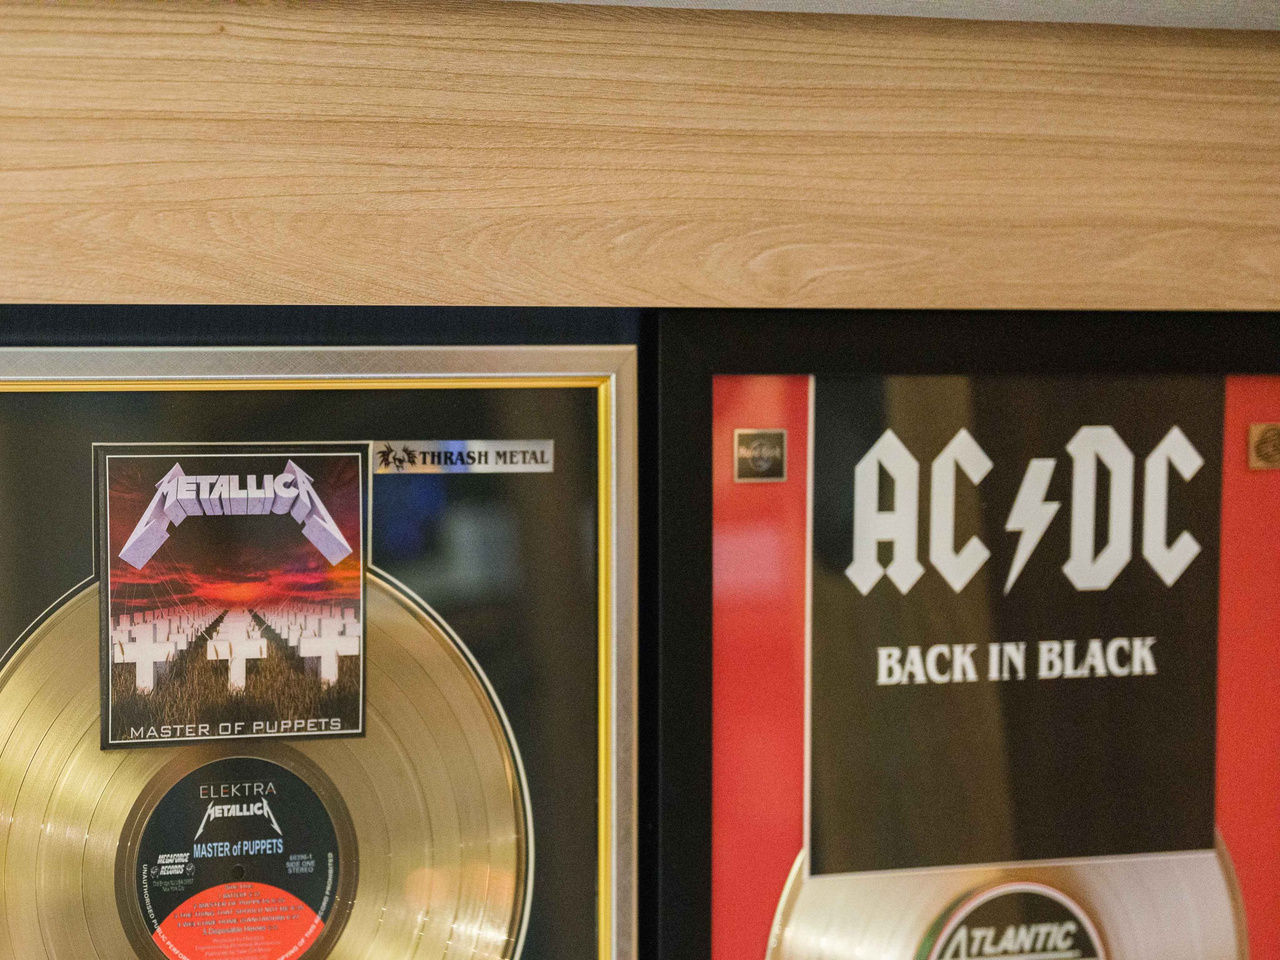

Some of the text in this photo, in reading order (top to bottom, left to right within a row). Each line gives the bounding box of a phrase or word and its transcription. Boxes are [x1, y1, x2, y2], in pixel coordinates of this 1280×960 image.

[419, 450, 549, 466] THRASH METAL
[118, 459, 354, 571] METALLICA
[876, 636, 1158, 687] BACK IN BLACK
[130, 718, 342, 739] MASTER OF PUPPETS
[199, 782, 277, 799] ELEKTRA
[194, 797, 283, 841] METALLICA
[193, 838, 284, 859] MASTER of PUPPETS
[152, 919, 168, 942] PUBLIC
